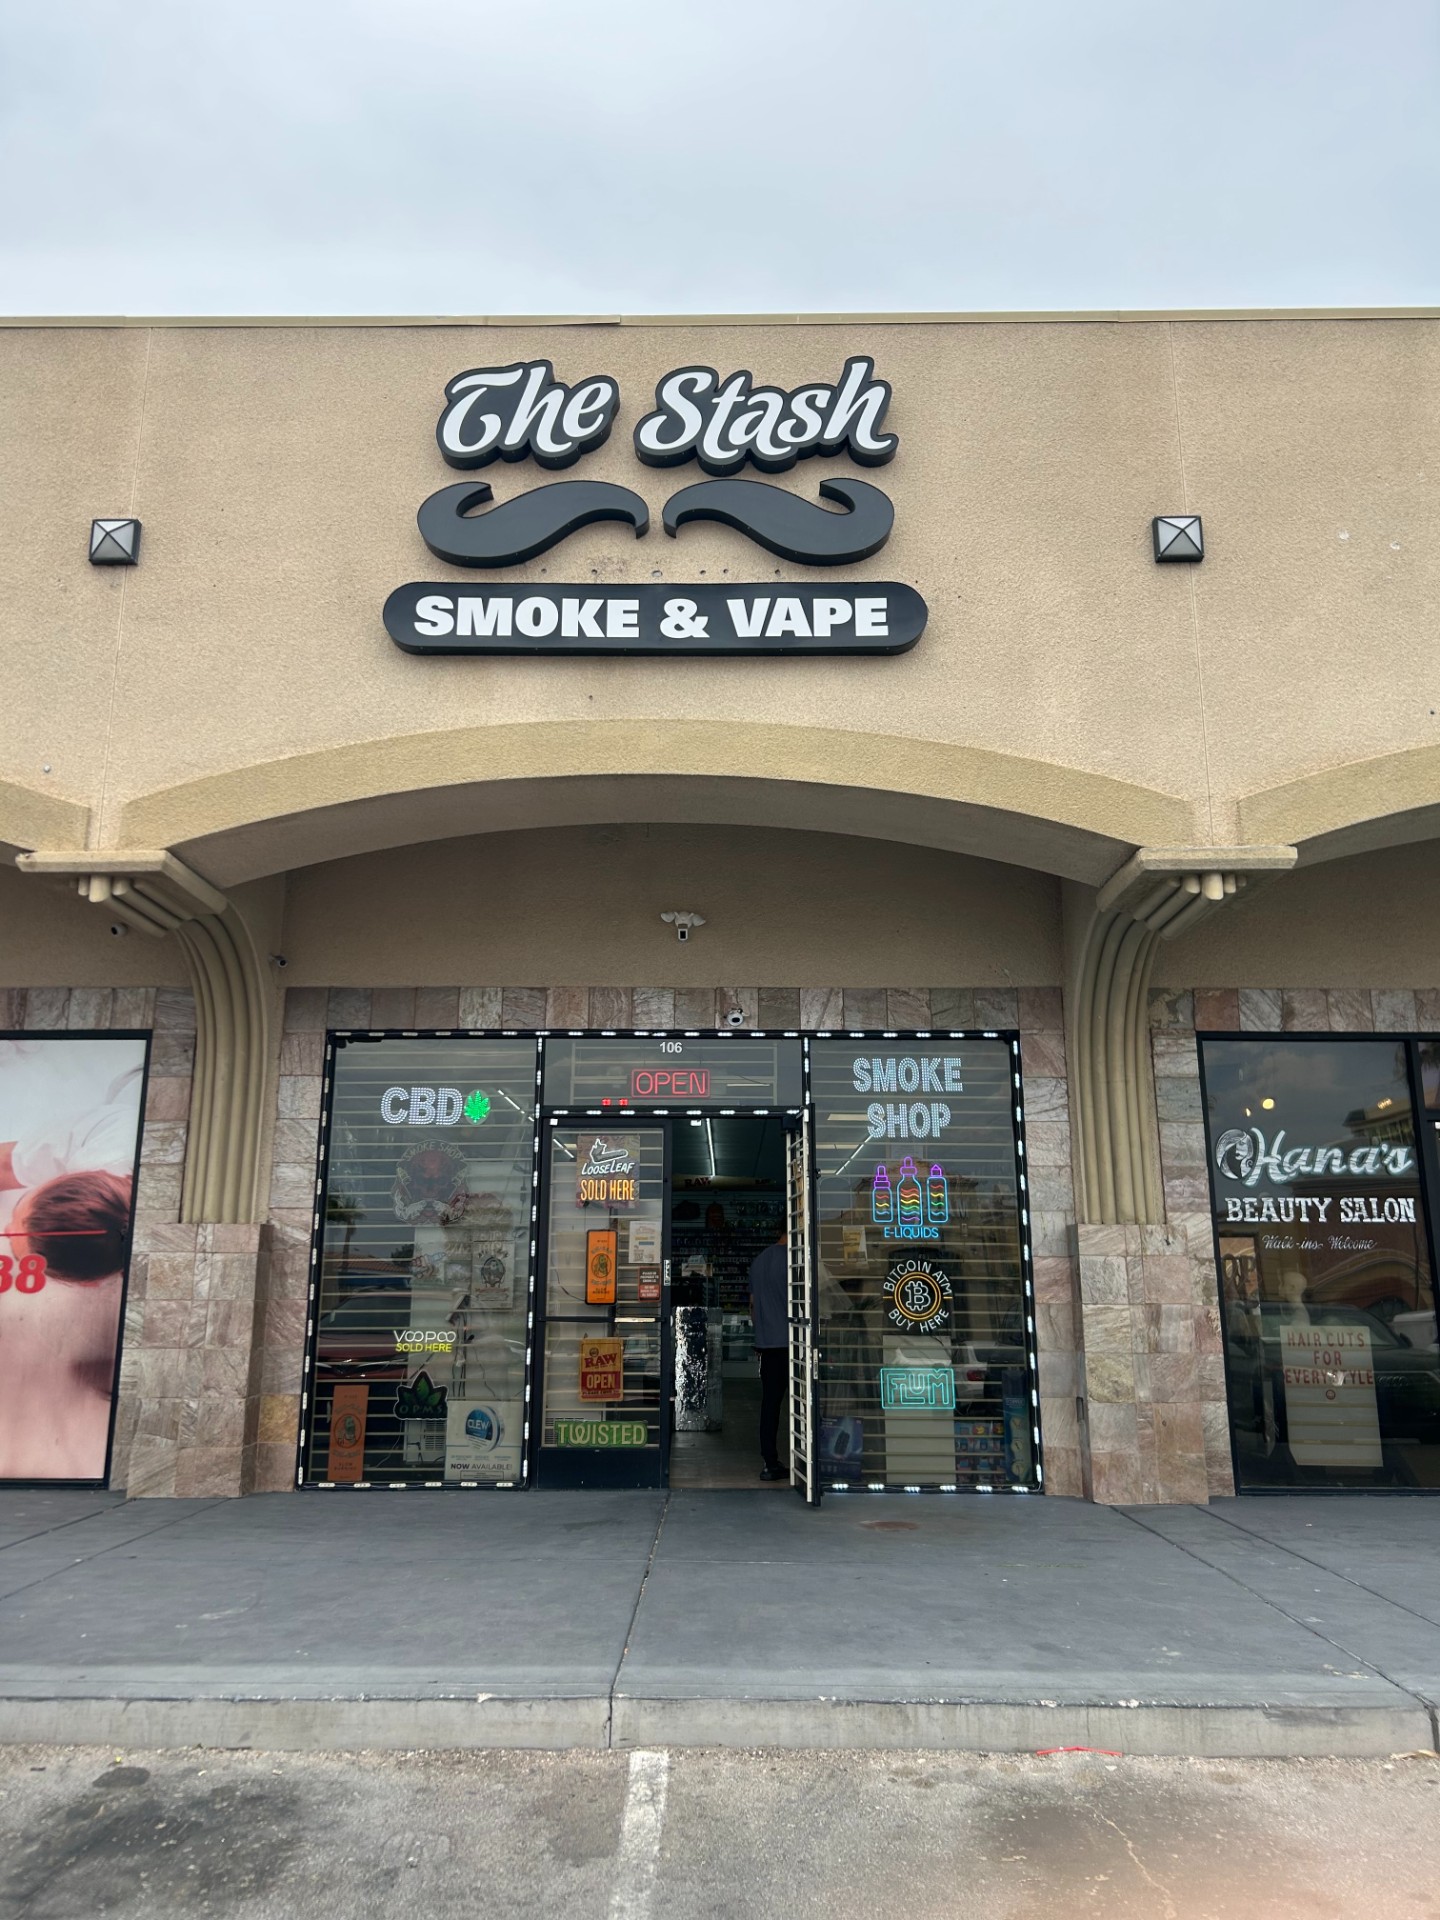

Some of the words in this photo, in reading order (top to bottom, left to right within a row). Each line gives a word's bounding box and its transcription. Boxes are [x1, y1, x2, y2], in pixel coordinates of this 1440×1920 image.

[440, 364, 615, 454] The
[637, 361, 895, 460] Stash
[413, 595, 641, 639] SMOKE
[659, 597, 711, 640] &
[726, 596, 890, 638] VAPE
[659, 1041, 683, 1054] 106
[635, 1071, 707, 1096] OPEN
[852, 1057, 964, 1093] SMOKE
[380, 1086, 464, 1126] CBD
[866, 1102, 952, 1138] SHOP
[403, 1141, 437, 1161] SMOKE
[439, 1142, 462, 1160] SHOP
[1241, 1127, 1414, 1187] Hana's
[580, 1179, 608, 1202] SOLD
[609, 1179, 635, 1201] HERE
[1225, 1197, 1332, 1223] BEAUTY
[1339, 1197, 1417, 1223] SALON
[883, 1226, 939, 1240] E-LIQUIDS
[1327, 1236, 1378, 1250] Welcome
[883, 1259, 932, 1292] BITCOIN
[932, 1270, 953, 1296] ATM
[888, 1308, 913, 1332] BUY
[919, 1308, 950, 1333] HERE
[393, 1330, 457, 1343] VOOPOO
[395, 1343, 424, 1353] SOLD
[425, 1343, 453, 1353] HERE
[1287, 1331, 1322, 1347] HAIR
[1326, 1332, 1365, 1348] CUTS
[584, 1352, 618, 1369] RAW
[1313, 1350, 1342, 1366] FOR
[586, 1373, 616, 1389] OPEN
[1284, 1368, 1328, 1385] EVERY
[557, 1422, 646, 1446] TWISTED
